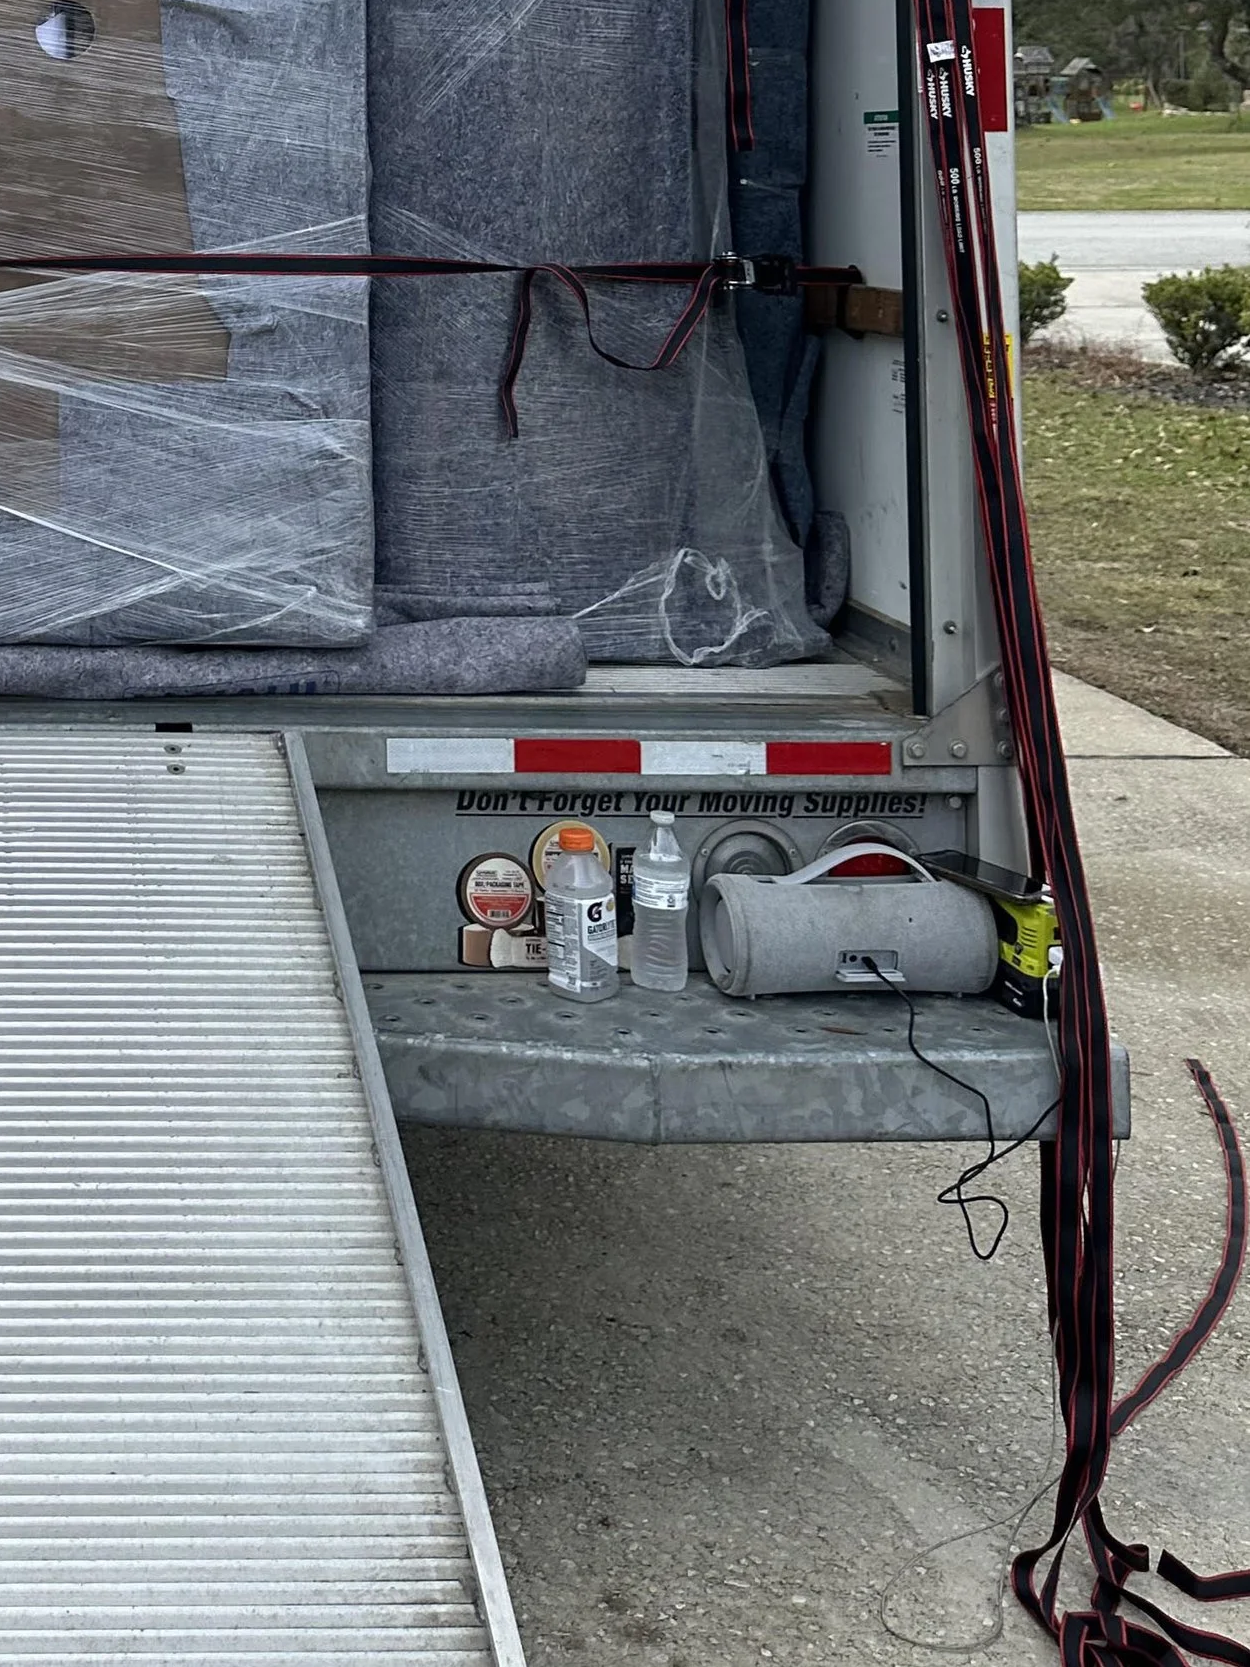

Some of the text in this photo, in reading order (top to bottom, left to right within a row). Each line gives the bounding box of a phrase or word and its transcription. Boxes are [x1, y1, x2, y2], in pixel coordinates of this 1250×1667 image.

[961, 58, 976, 96] HUSKY
[928, 82, 939, 120] HUSKY
[939, 80, 953, 118] HUSKY
[973, 147, 982, 165] 500
[949, 168, 960, 185] 500
[456, 790, 928, 818] Don't Forget Your Moving Supplies!
